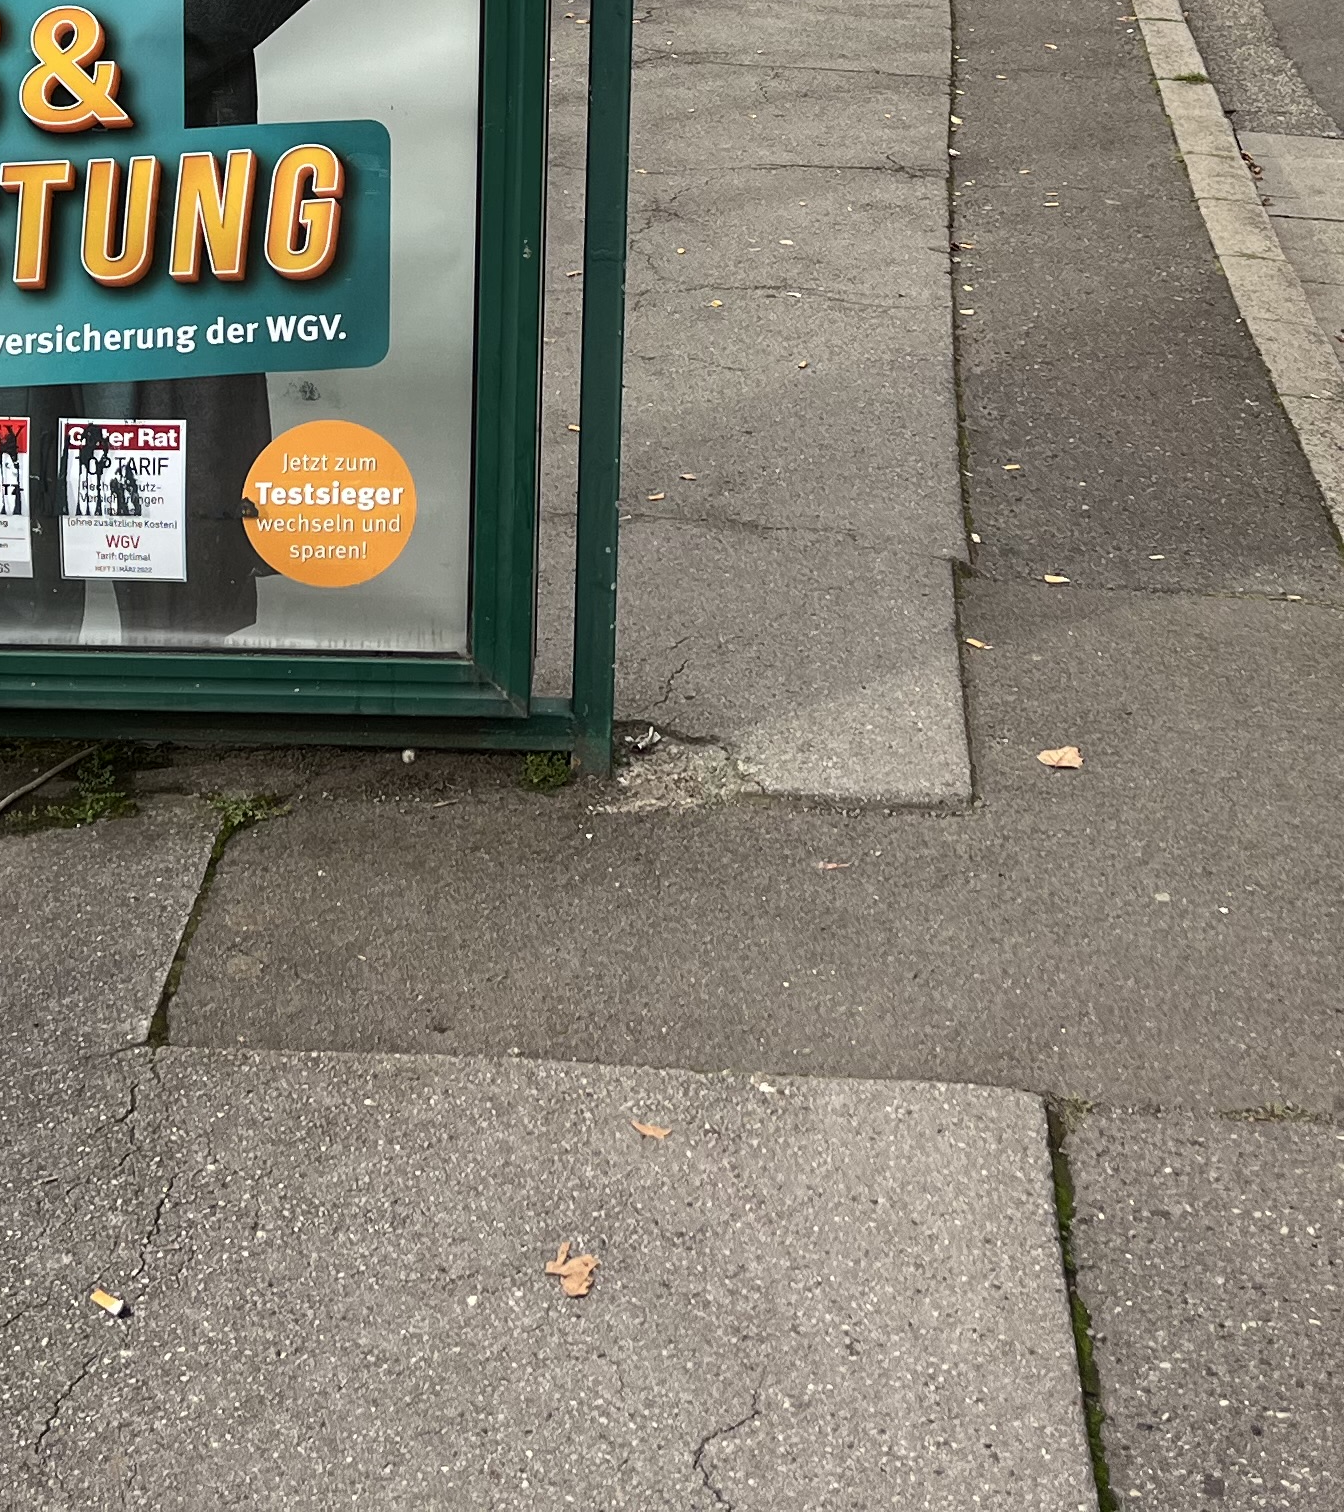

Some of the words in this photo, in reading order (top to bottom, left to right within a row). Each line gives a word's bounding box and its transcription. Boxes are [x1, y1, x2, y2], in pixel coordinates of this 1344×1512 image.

[19, 5, 134, 135] &
[205, 316, 259, 346] der
[266, 313, 347, 342] WGV.
[138, 427, 178, 447] Rat
[115, 456, 169, 476] TARIF
[281, 453, 329, 473] Jetzt
[334, 455, 377, 472] zum
[255, 481, 404, 511] Testsieger
[257, 514, 354, 533] wechseln
[362, 514, 401, 533] und
[105, 534, 141, 548] WGV
[118, 552, 151, 562] Optimal
[289, 541, 368, 563] sparen!
